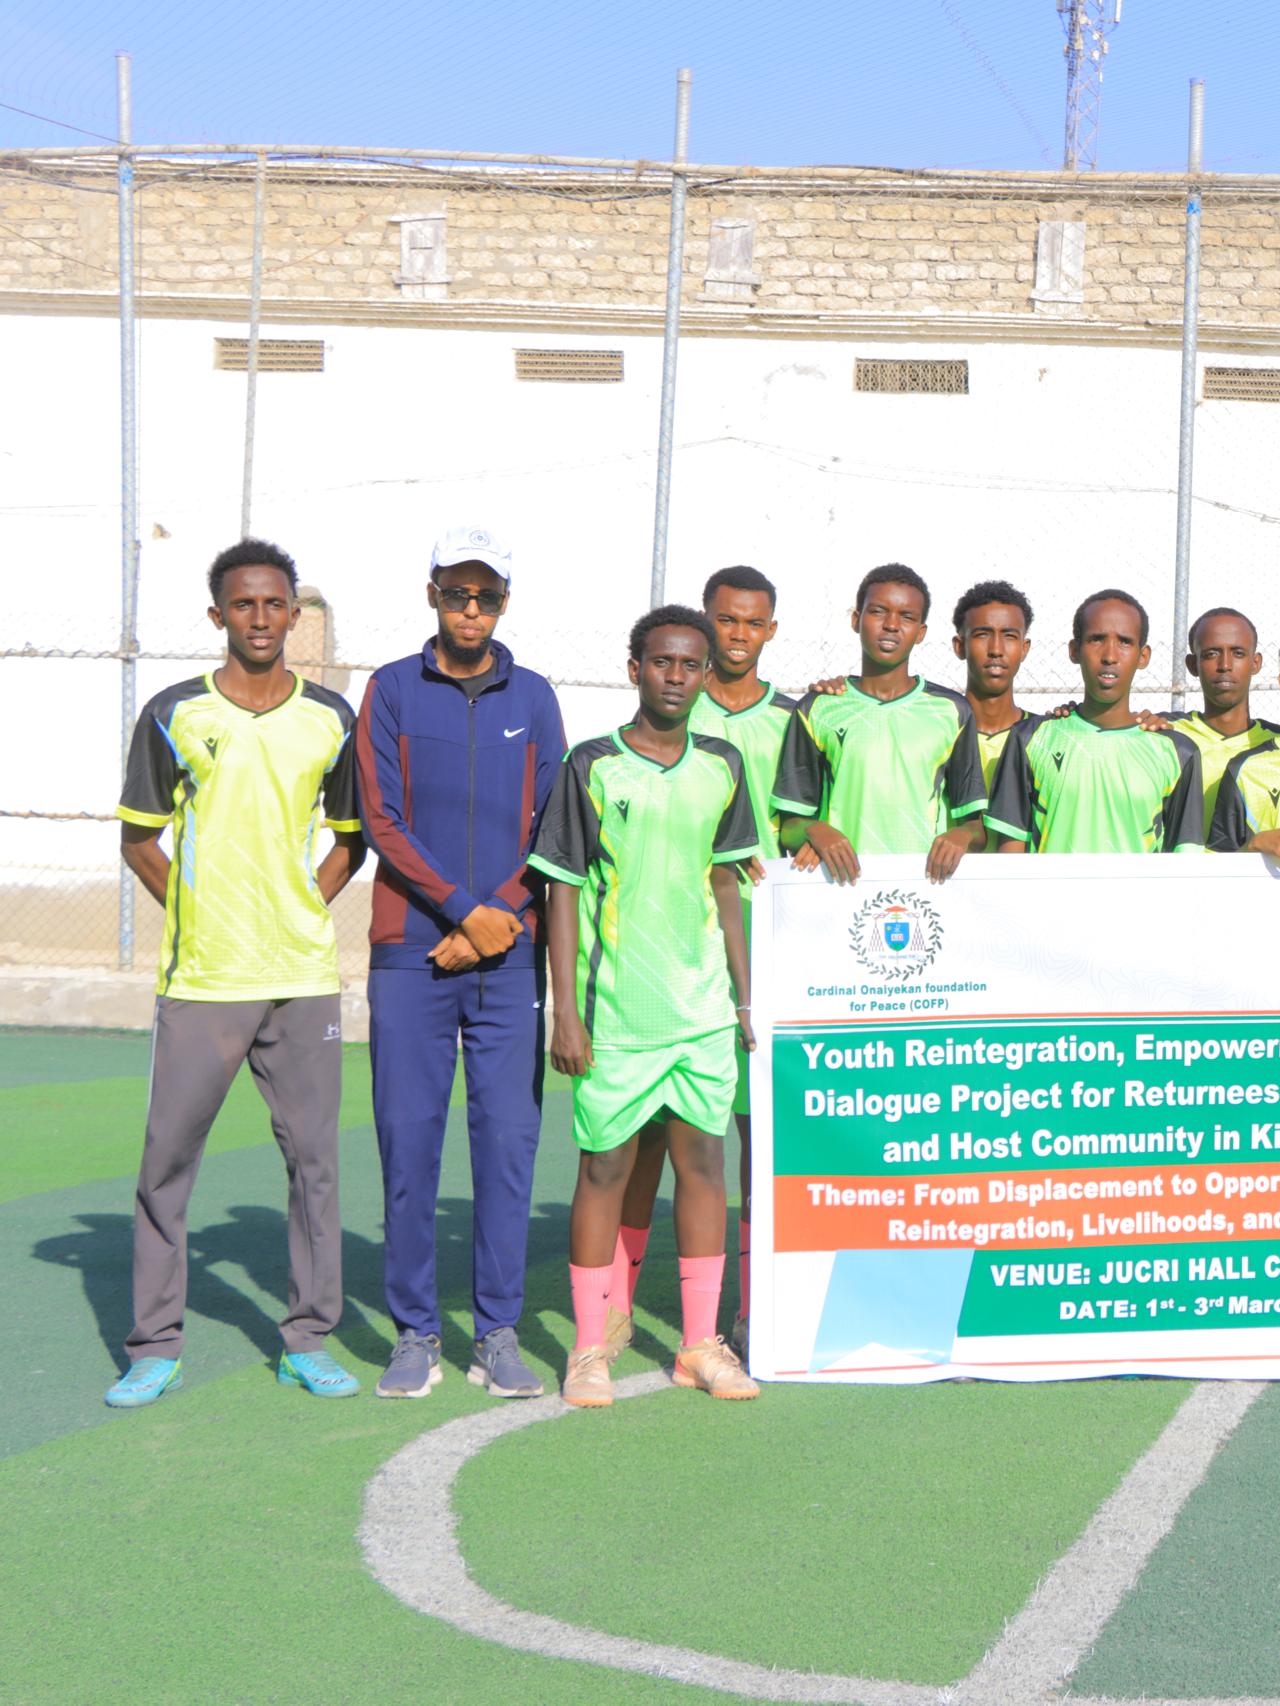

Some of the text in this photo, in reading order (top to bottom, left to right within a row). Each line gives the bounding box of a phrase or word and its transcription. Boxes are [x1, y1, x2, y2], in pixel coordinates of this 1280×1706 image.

[807, 981, 987, 997] Cardinal Onaiyekan foundation
[849, 997, 949, 1012] for Peace (COFP)
[801, 1035, 895, 1070] Youth
[905, 1034, 1125, 1071] Reintegration,
[804, 1087, 942, 1123] Dialogue
[951, 1082, 1063, 1118] Project
[1070, 1080, 1116, 1108] for
[1124, 1079, 1280, 1107] Returnees
[882, 1133, 940, 1163] and
[950, 1130, 1023, 1161] Host
[1031, 1125, 1205, 1159] Community
[1213, 1124, 1241, 1151] in
[806, 1183, 905, 1207] Theme:
[914, 1182, 981, 1206] From
[987, 1174, 1164, 1208] Displacement
[1170, 1173, 1198, 1196] to
[888, 1215, 1075, 1245] Reintegration,
[1082, 1208, 1235, 1237] Livelihoods,
[990, 1262, 1091, 1287] VENUE:
[1098, 1258, 1180, 1285] JUCRI
[1188, 1255, 1257, 1281] HALL
[1059, 1299, 1137, 1320] DATE:
